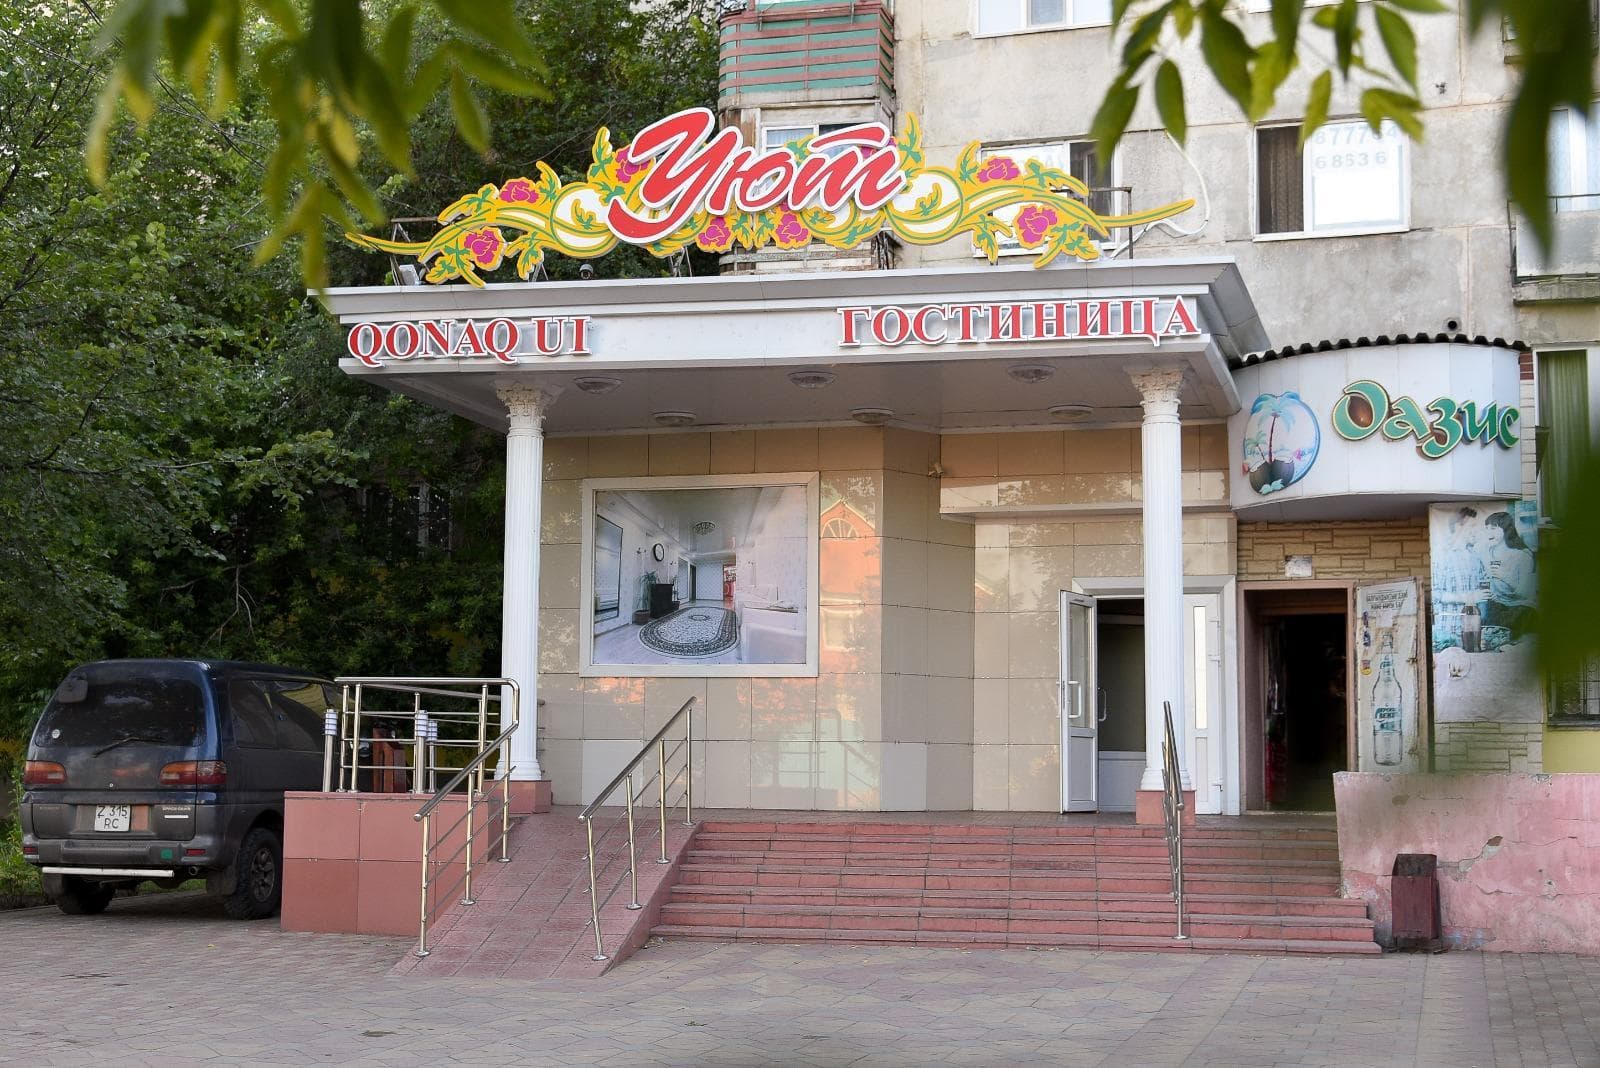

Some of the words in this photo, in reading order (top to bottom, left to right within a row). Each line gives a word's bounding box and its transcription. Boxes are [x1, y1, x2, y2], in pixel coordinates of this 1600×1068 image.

[608, 107, 907, 244] Уют
[348, 318, 520, 368] QONAQ
[532, 316, 592, 356] UI
[837, 295, 1201, 347] ГОСТИНИЦА
[1331, 379, 1521, 460] Оазис
[97, 805, 106, 817] Z
[109, 805, 128, 817] 315
[104, 817, 119, 829] RC
